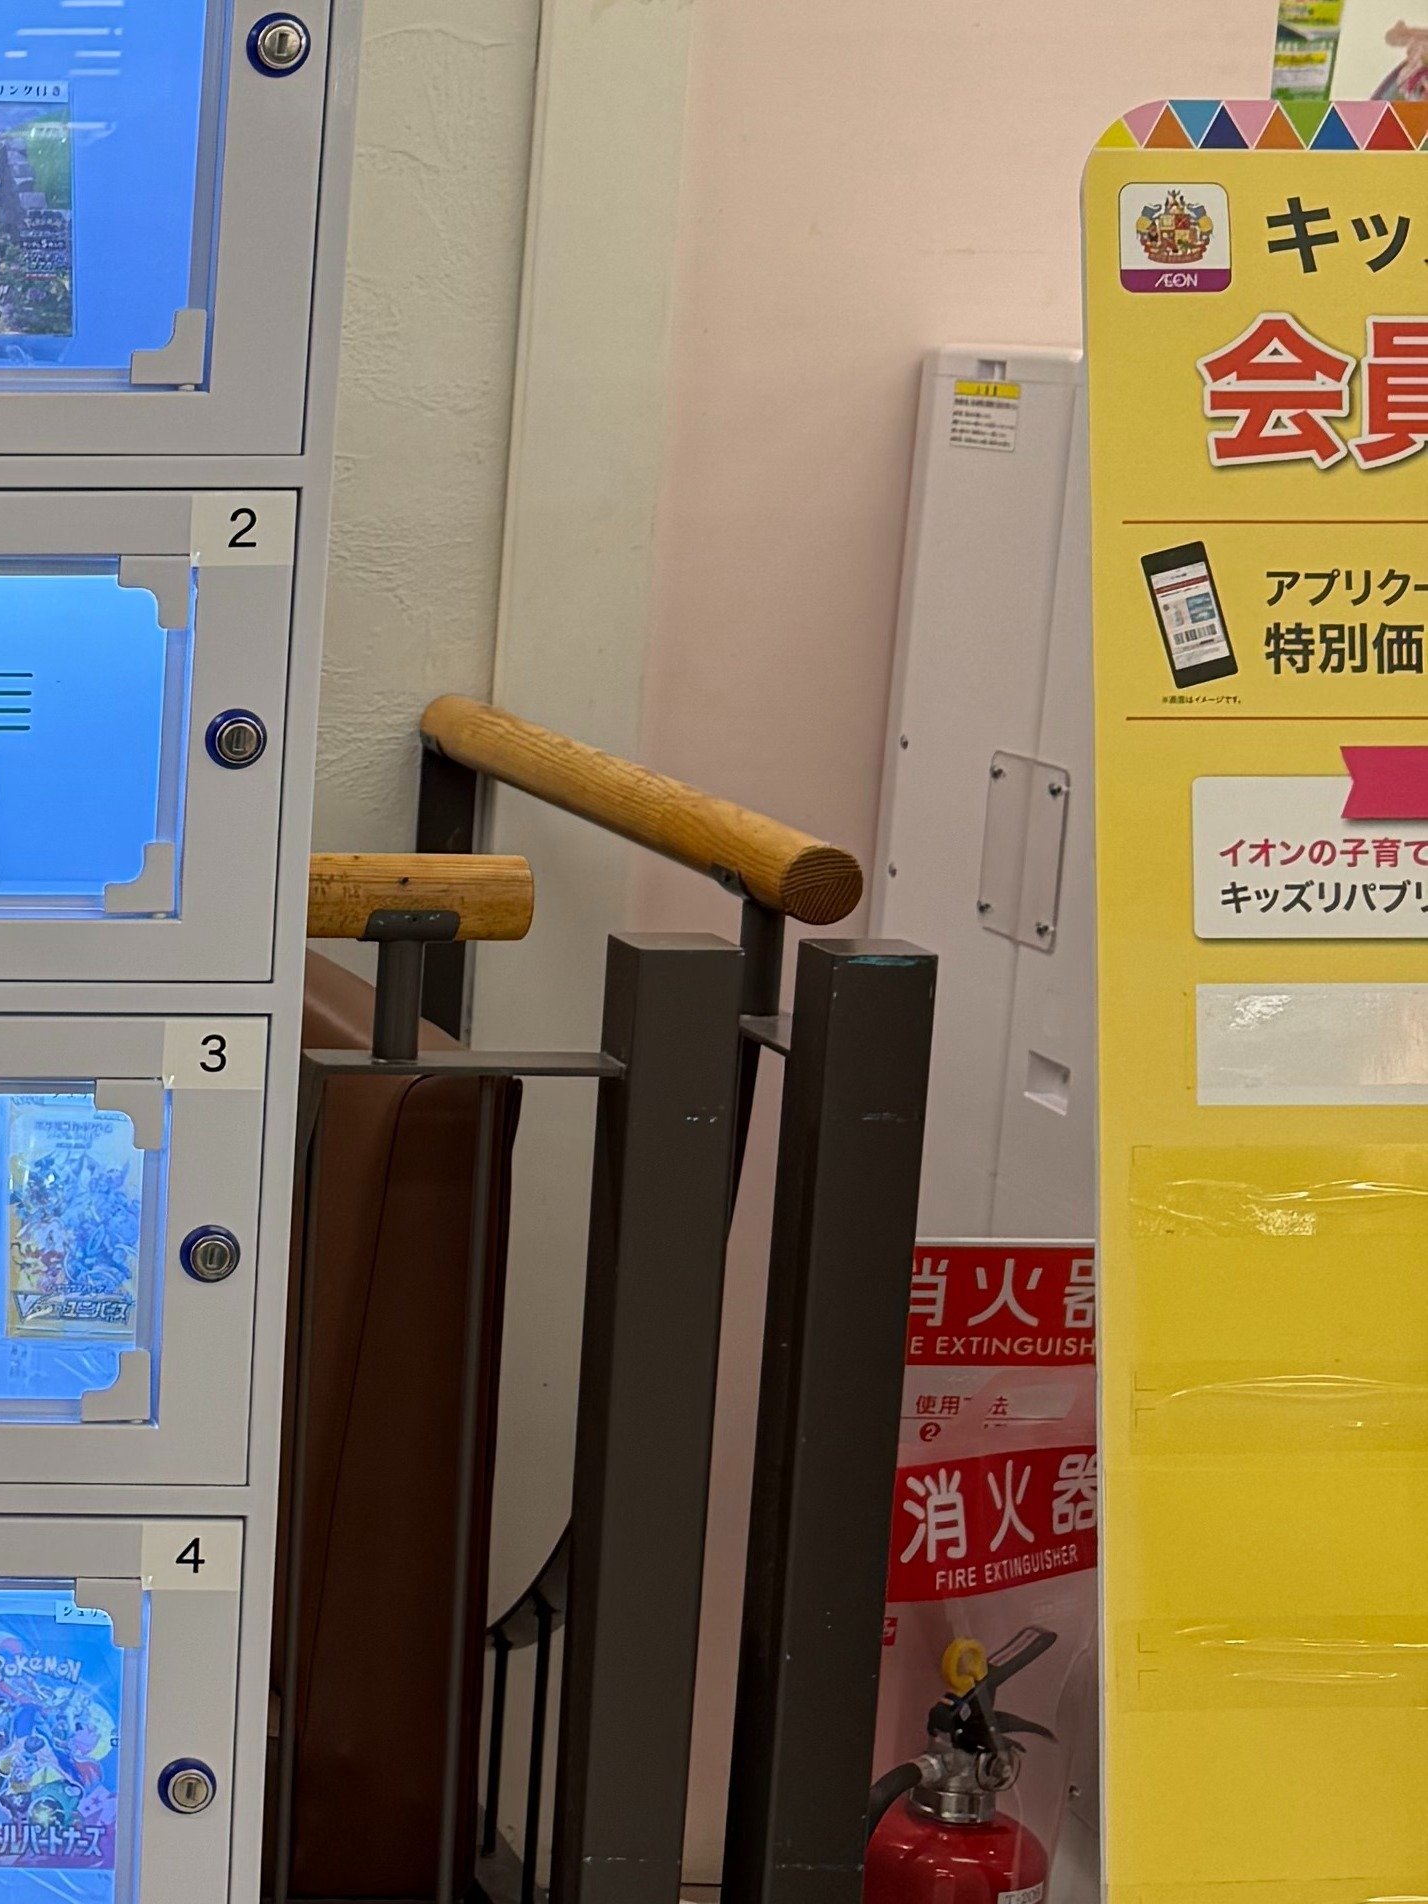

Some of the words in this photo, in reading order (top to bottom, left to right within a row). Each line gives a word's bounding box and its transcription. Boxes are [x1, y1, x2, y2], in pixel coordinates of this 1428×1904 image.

[228, 506, 258, 549] 2
[1263, 622, 1425, 675] 特別価
[1218, 837, 1428, 869] イオンの子育て
[199, 1033, 228, 1073] 3
[915, 1394, 1009, 1416] 使用法
[899, 1452, 1096, 1564] 消火器
[174, 1536, 206, 1573] 4
[935, 1566, 978, 1591] FIRE
[984, 1543, 1079, 1584] EXTINGUISHER
